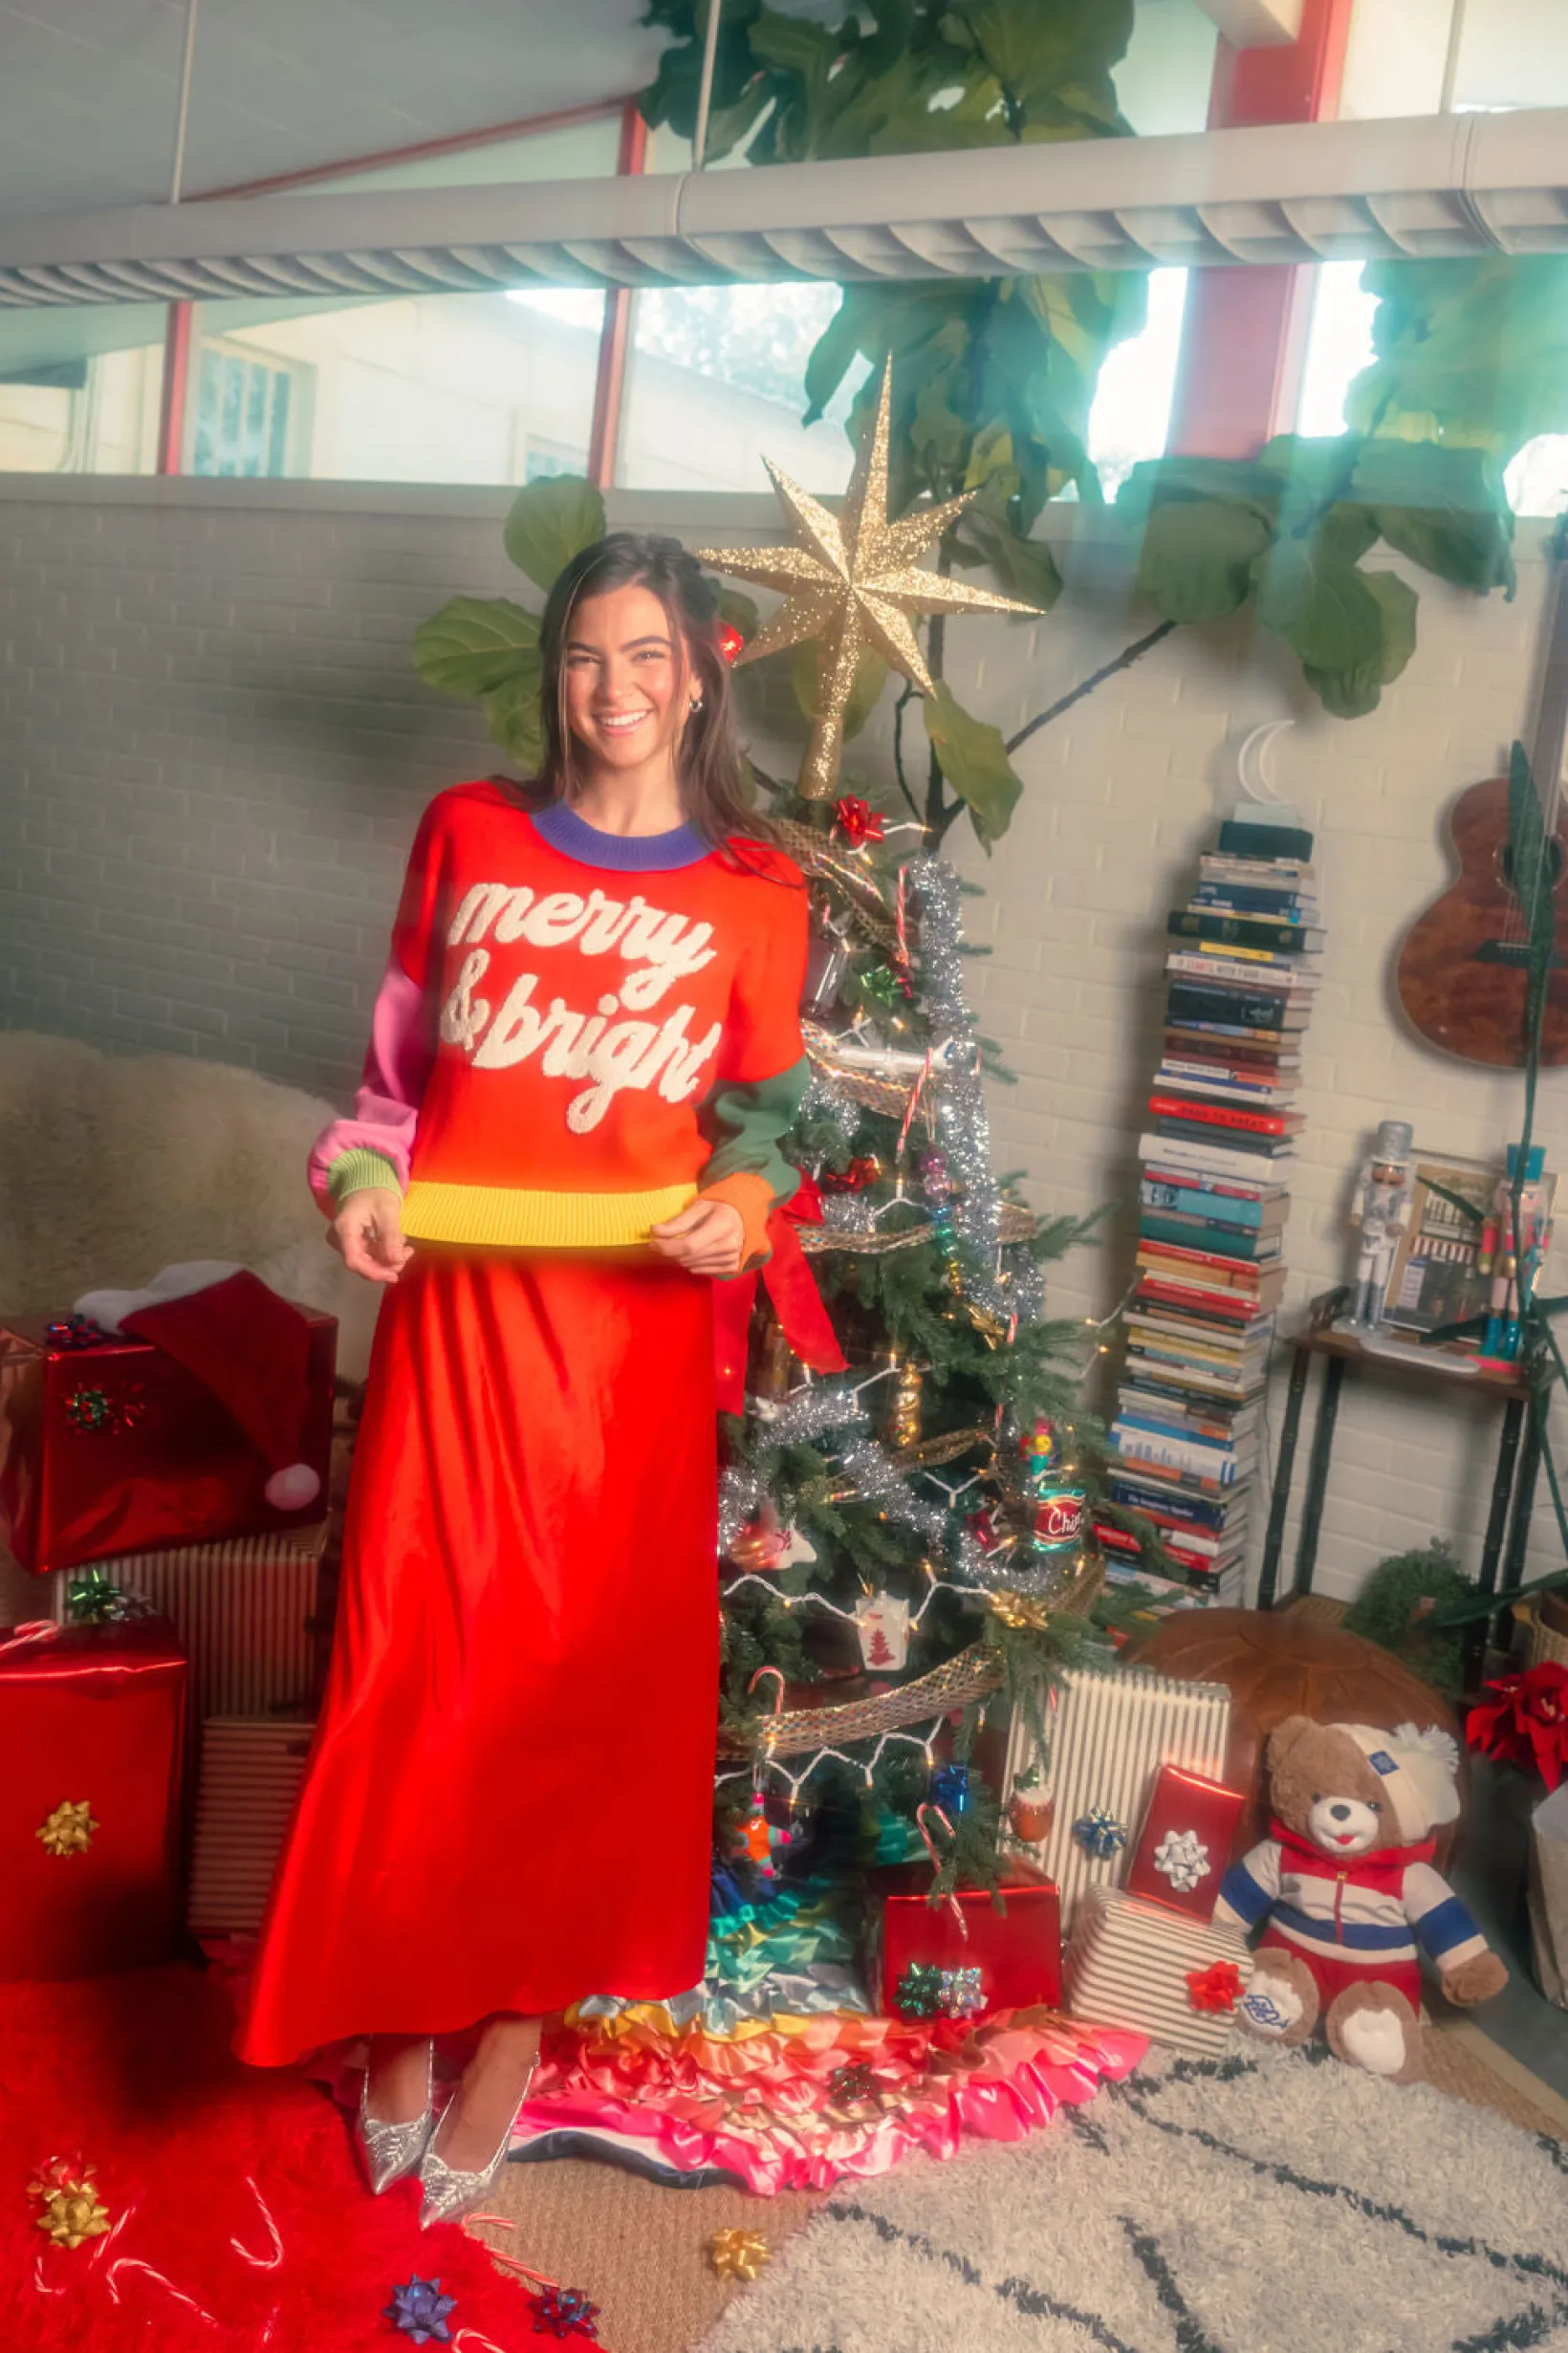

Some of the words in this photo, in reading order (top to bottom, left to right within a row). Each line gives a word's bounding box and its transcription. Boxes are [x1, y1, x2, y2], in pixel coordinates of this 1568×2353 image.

[446, 882, 717, 1011] merry
[440, 948, 490, 1052] &
[471, 973, 723, 1134] bright
